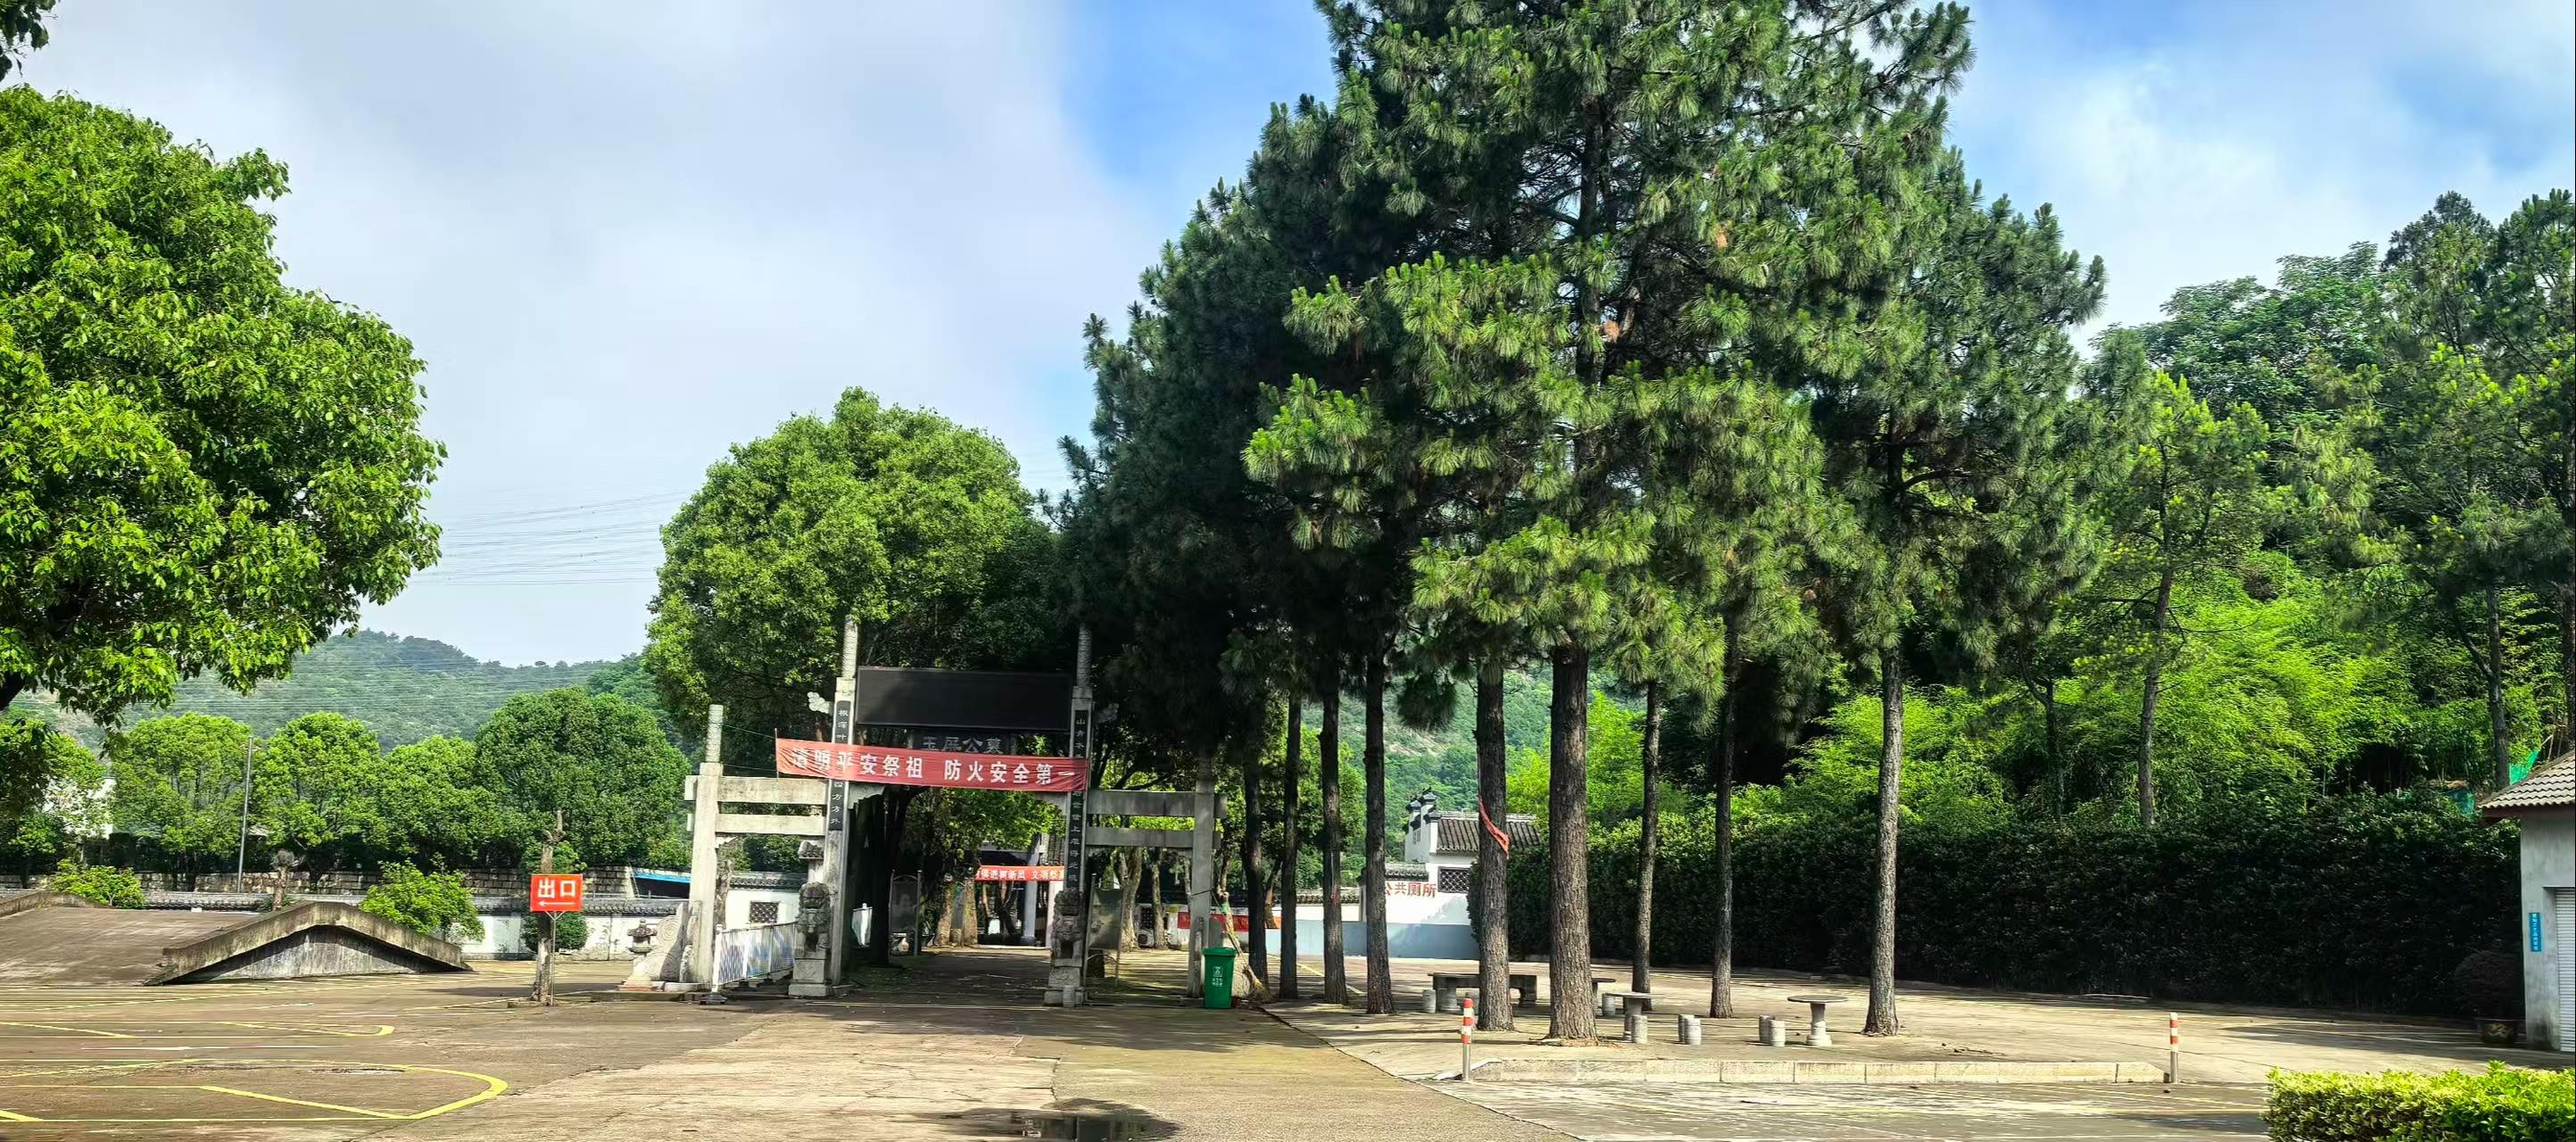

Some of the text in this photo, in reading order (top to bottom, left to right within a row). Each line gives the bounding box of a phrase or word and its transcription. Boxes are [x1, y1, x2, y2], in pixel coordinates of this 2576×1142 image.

[791, 746, 1075, 785] 清明平安祭祖 防火安全第一
[538, 877, 576, 898] 出口
